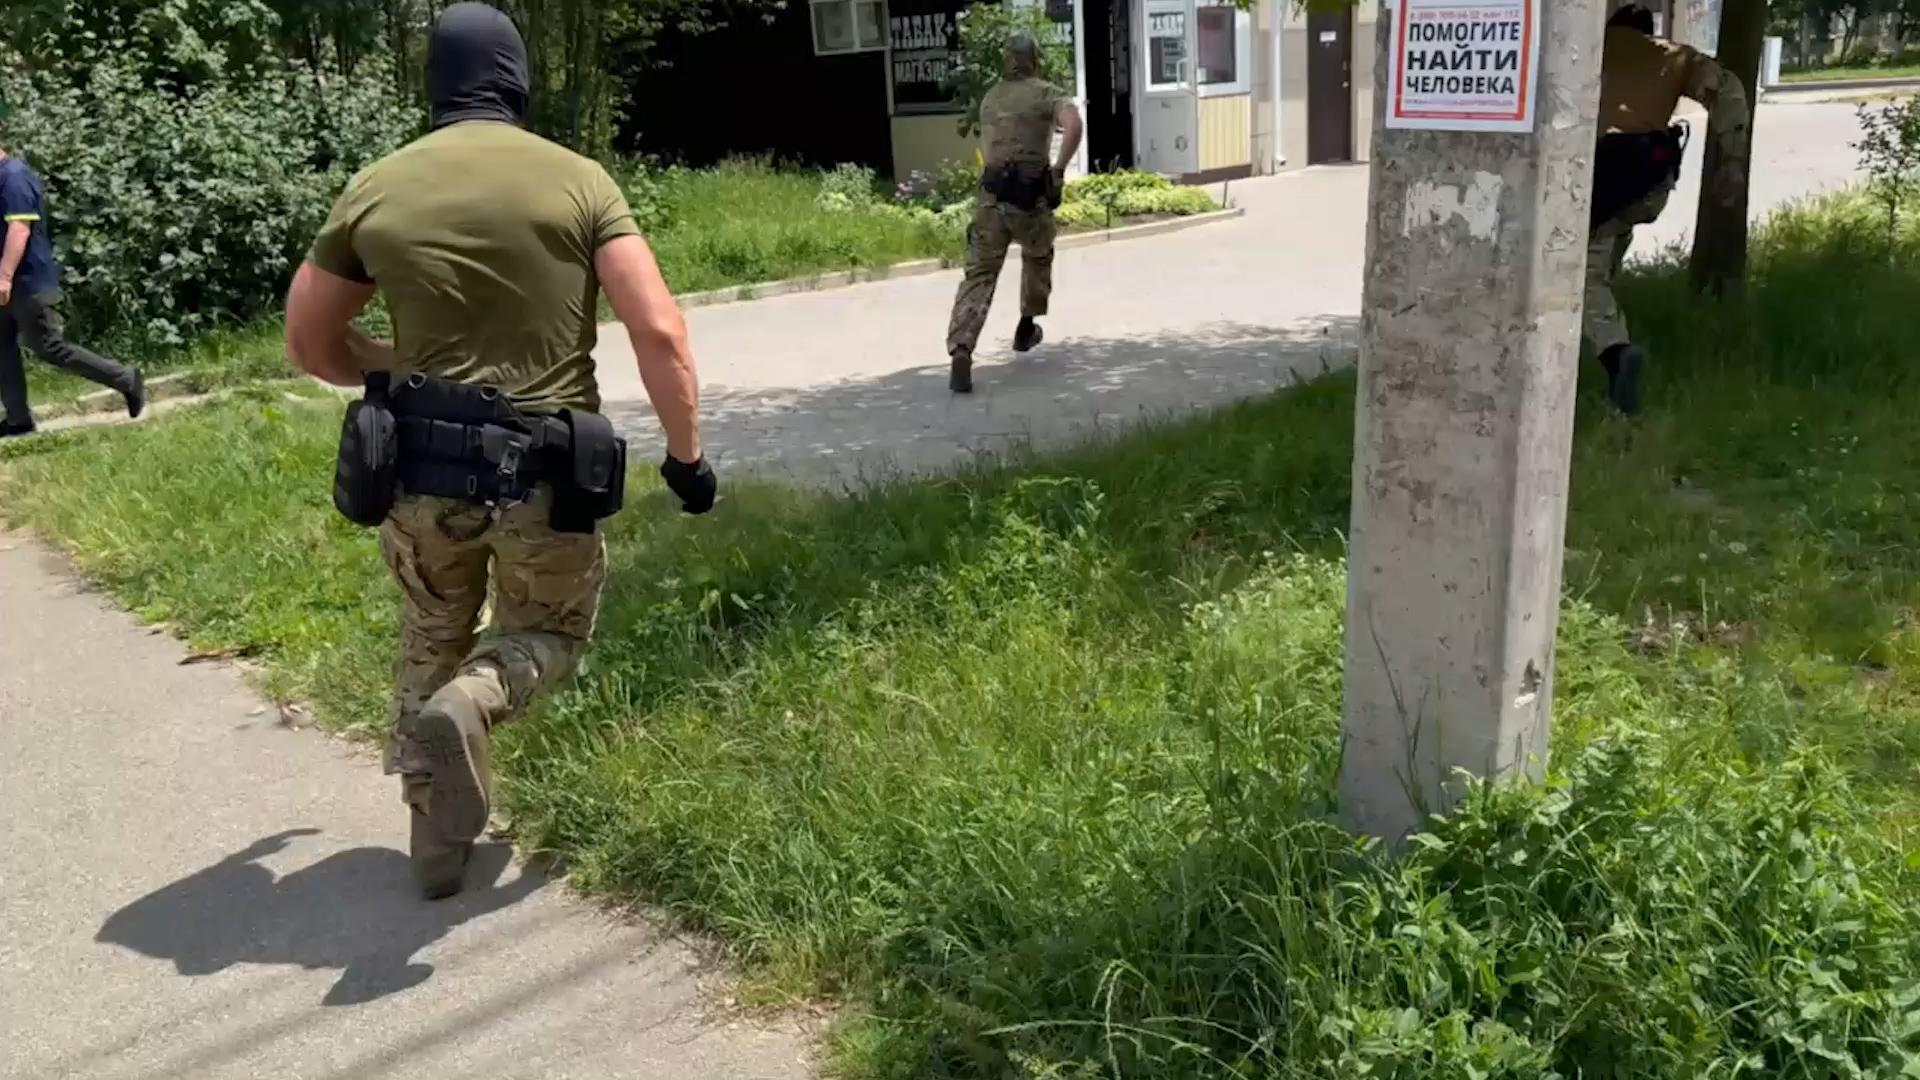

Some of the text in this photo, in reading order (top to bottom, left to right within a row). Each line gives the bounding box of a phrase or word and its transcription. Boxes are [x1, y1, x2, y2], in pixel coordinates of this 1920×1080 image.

[1409, 22, 1520, 42] ПОМОГИТЕ
[1407, 43, 1518, 70] НАЙТИ
[1406, 76, 1515, 94] ЧЕЛОВЕКА
